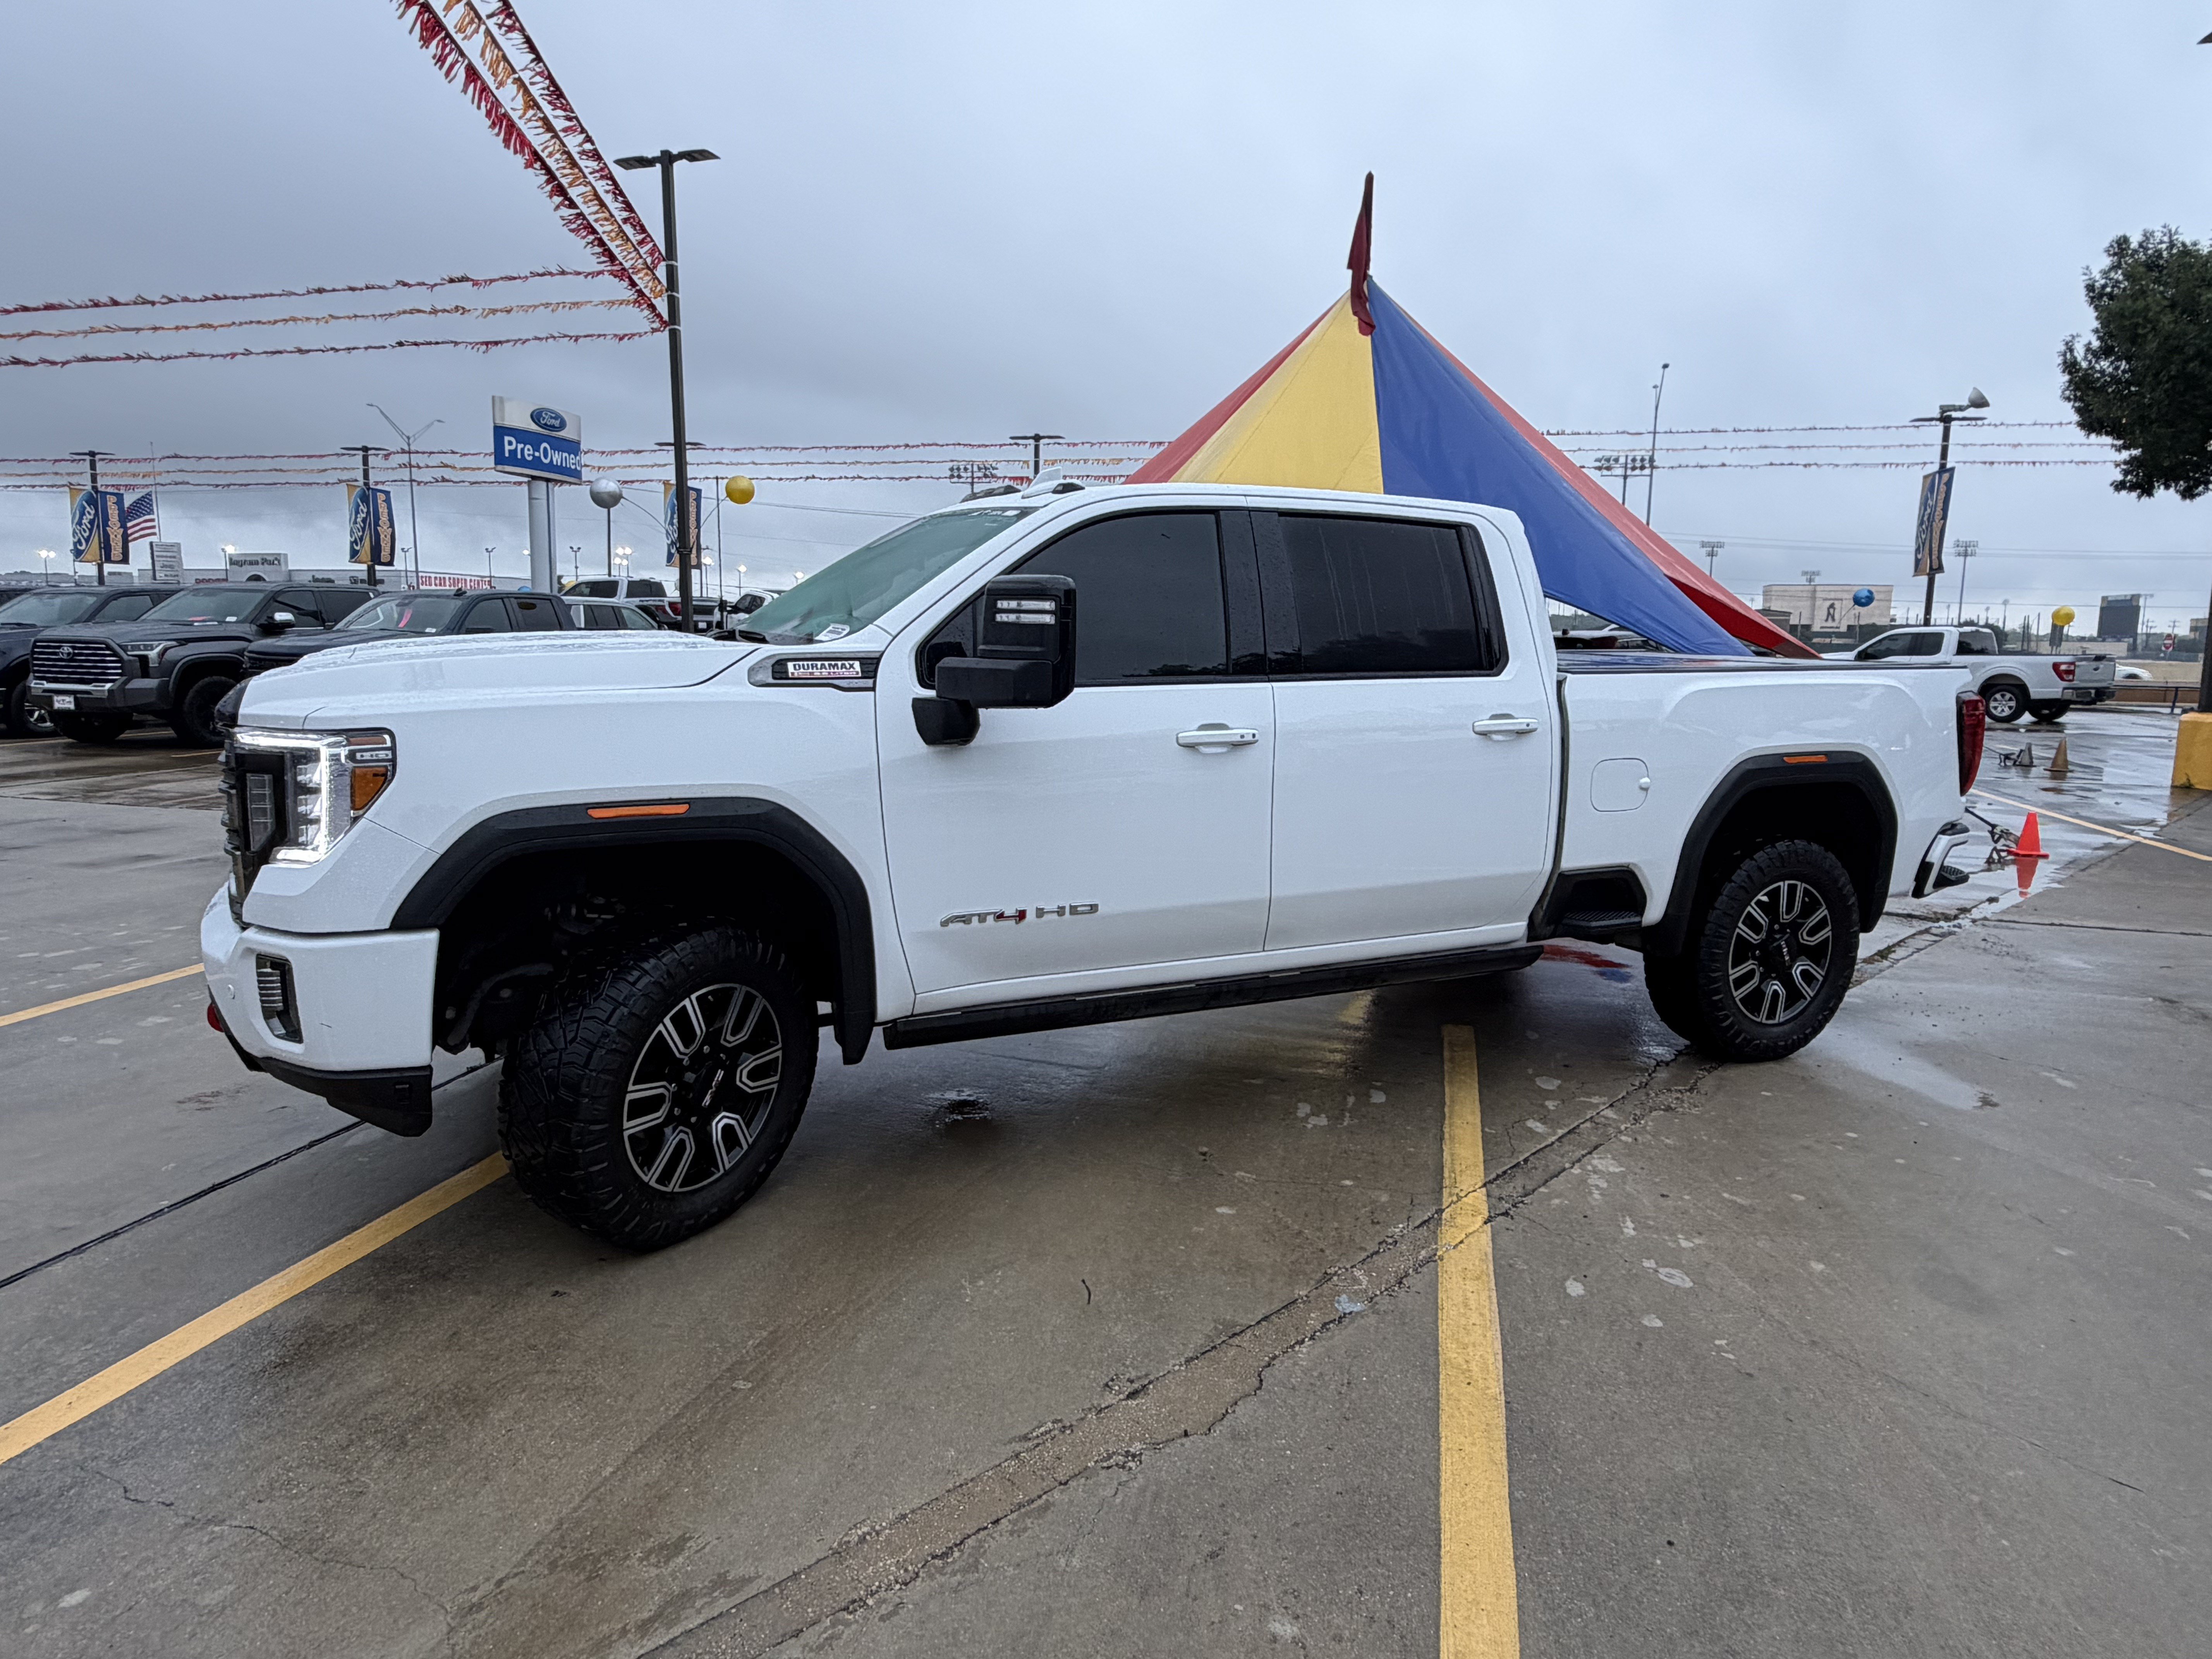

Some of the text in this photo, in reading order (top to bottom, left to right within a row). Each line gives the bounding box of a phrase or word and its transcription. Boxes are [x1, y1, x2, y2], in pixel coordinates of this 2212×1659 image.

[540, 411, 560, 427] Ford
[504, 436, 581, 471] Pre-Owned
[72, 501, 95, 550] Ford
[350, 497, 367, 550] Ford
[793, 662, 856, 671] DURAMAX
[941, 901, 1099, 927] AT4 HD
